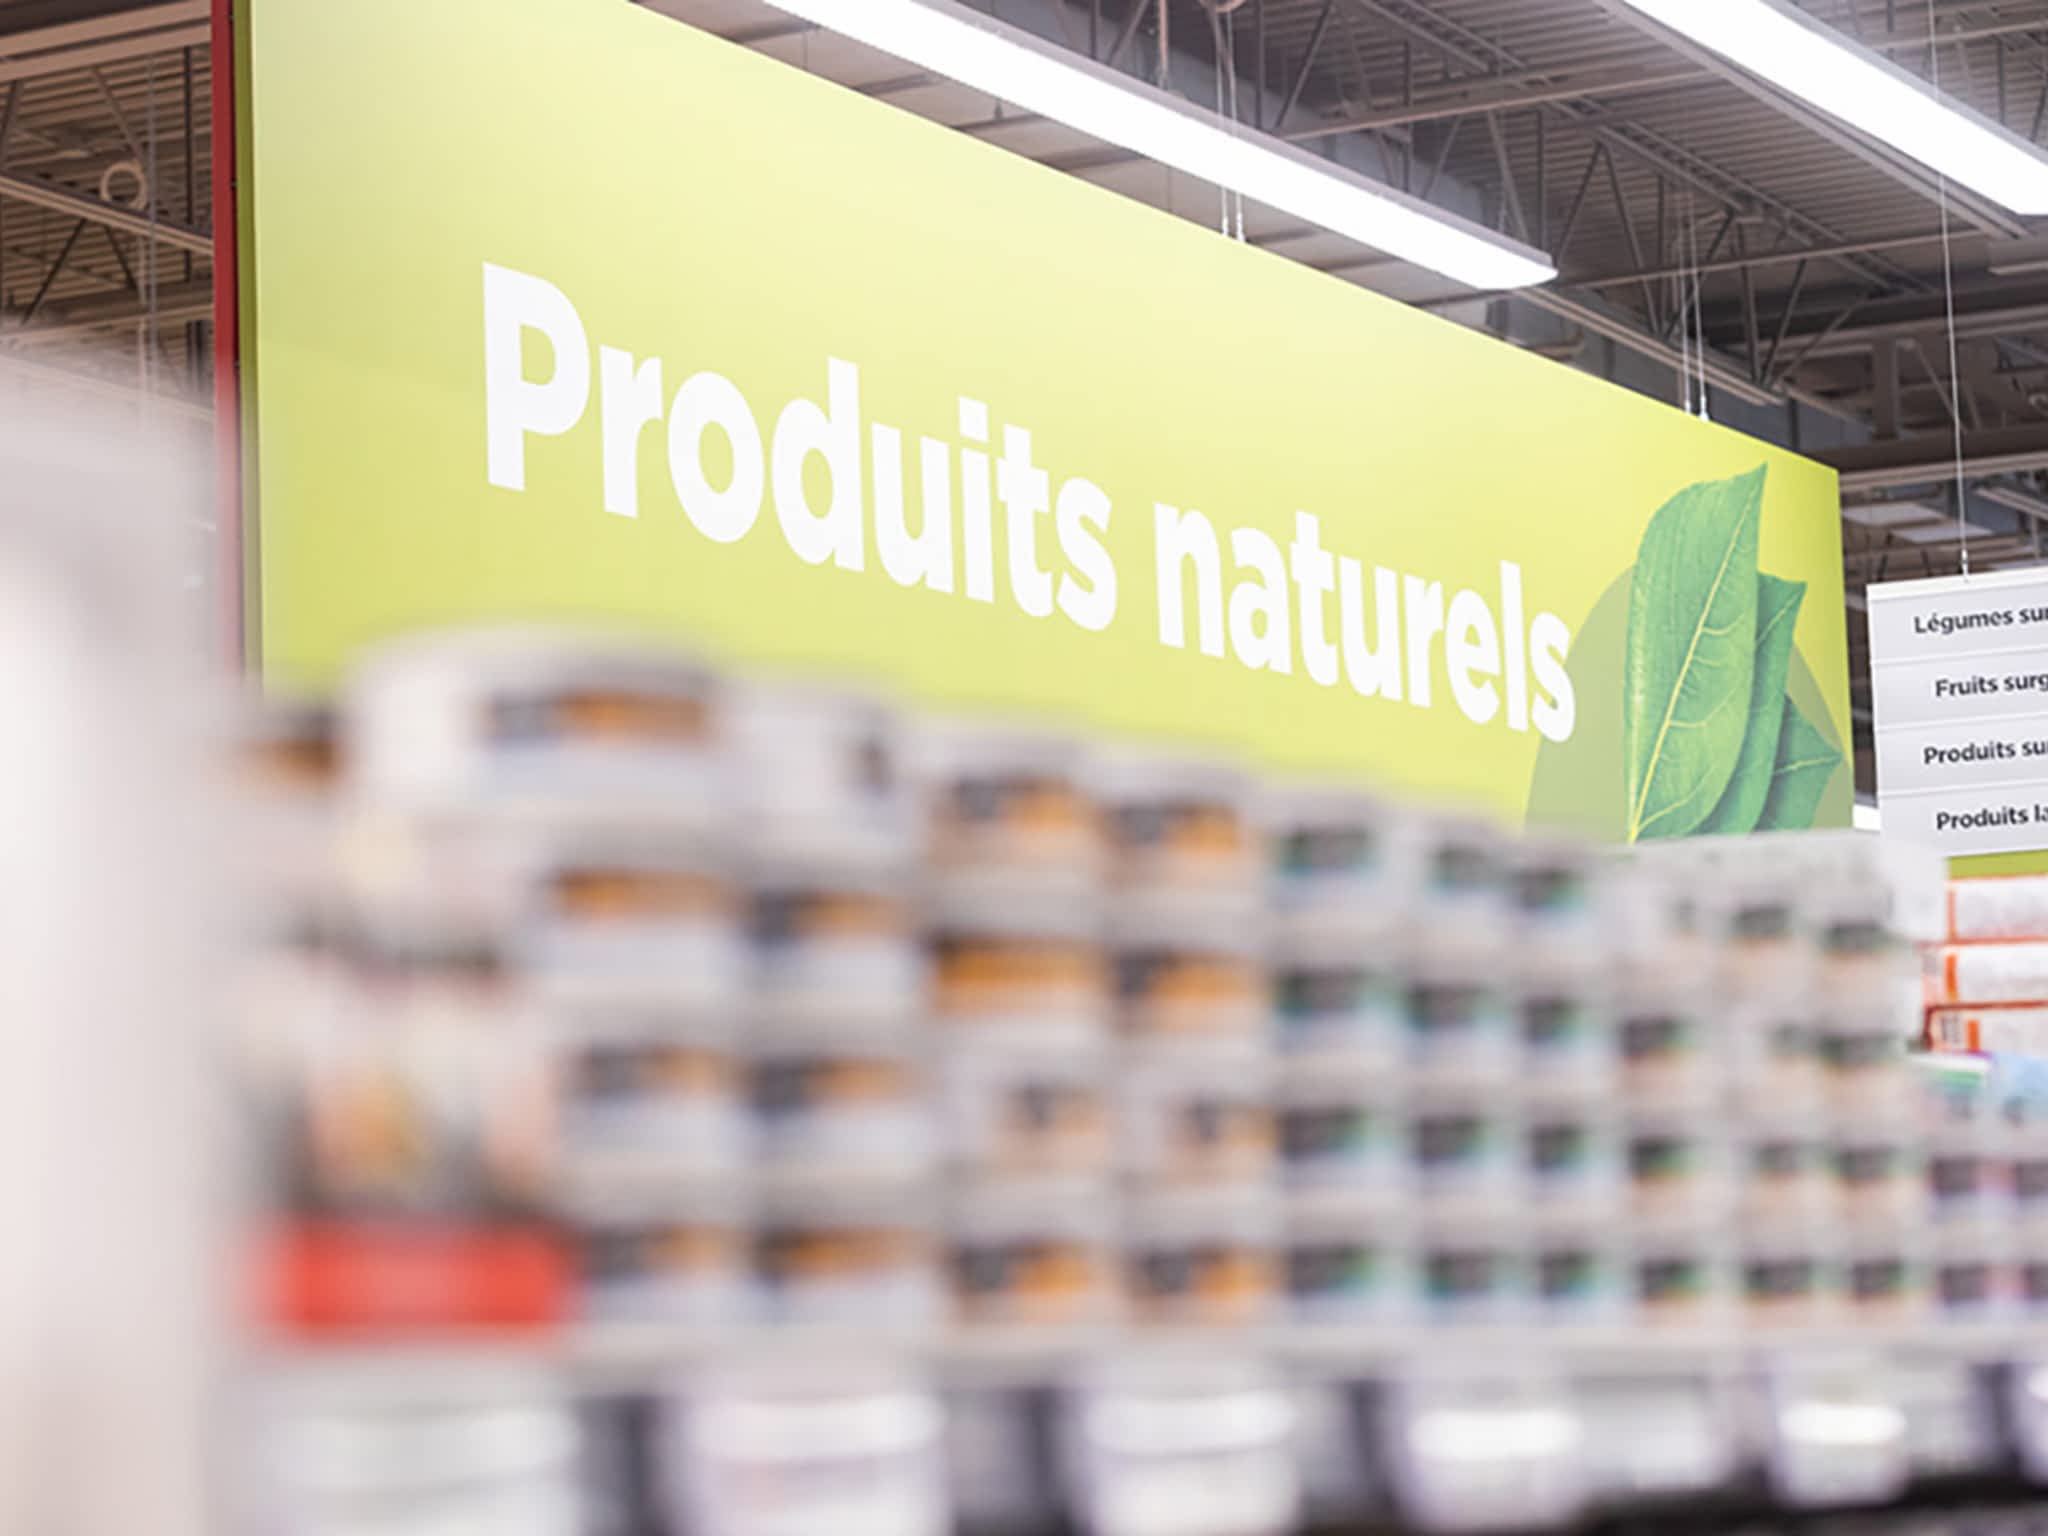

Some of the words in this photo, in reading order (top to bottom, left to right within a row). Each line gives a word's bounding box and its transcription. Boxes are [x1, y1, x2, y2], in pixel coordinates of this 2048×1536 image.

[483, 262, 1117, 631] Produits
[1154, 502, 1576, 742] naturels
[1914, 609, 2014, 635] Légumes
[1935, 675, 1999, 697] Fruits
[1923, 740, 2017, 765] Produits
[2021, 740, 2048, 757] su
[1936, 805, 2030, 831] Produits
